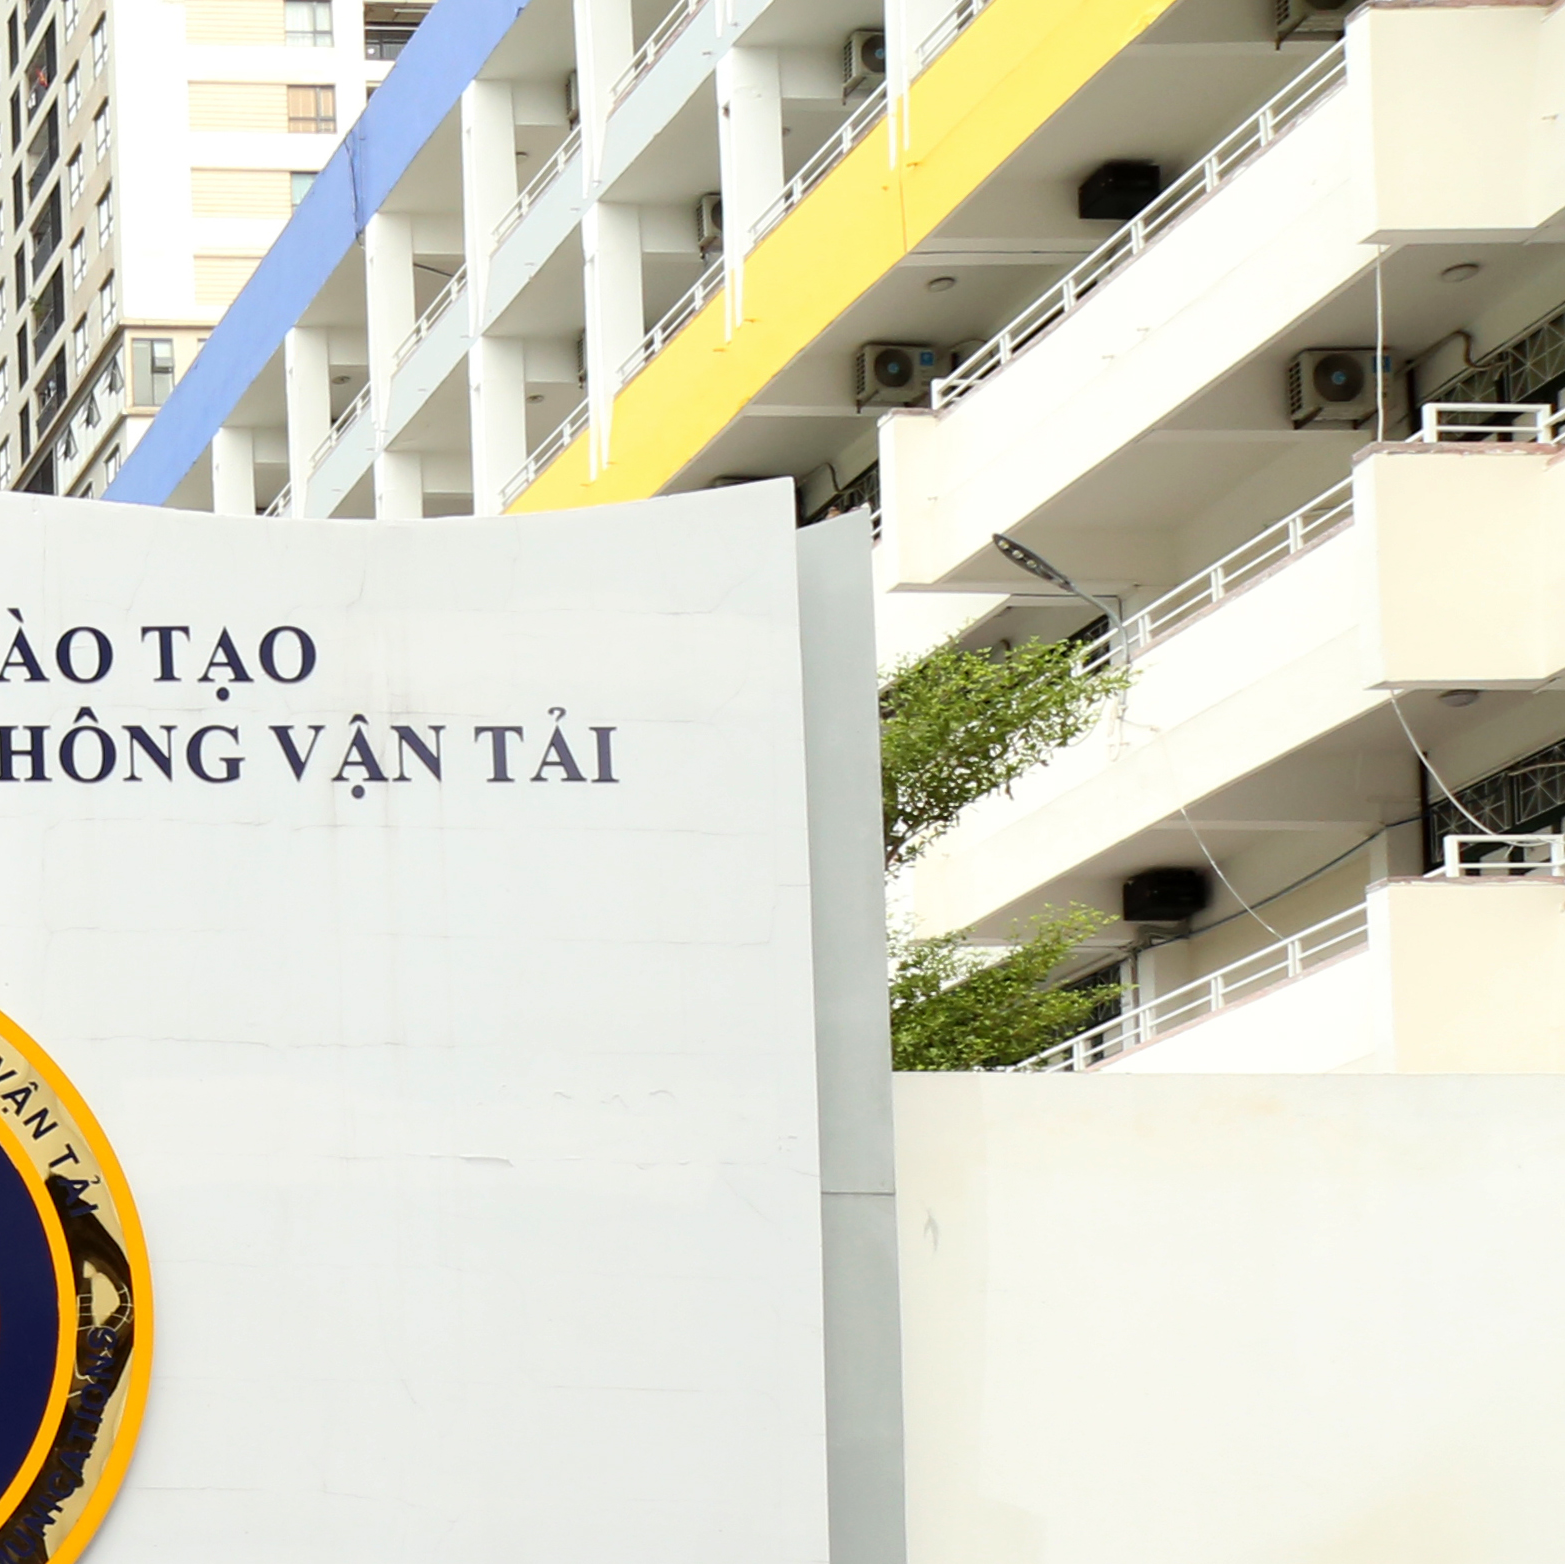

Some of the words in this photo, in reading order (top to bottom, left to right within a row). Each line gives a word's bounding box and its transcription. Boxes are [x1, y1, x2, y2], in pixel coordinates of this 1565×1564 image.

[140, 625, 317, 702] TẠO
[268, 713, 446, 799] VẬN
[474, 706, 620, 783] TẢI
[49, 1143, 102, 1220] TẢI
